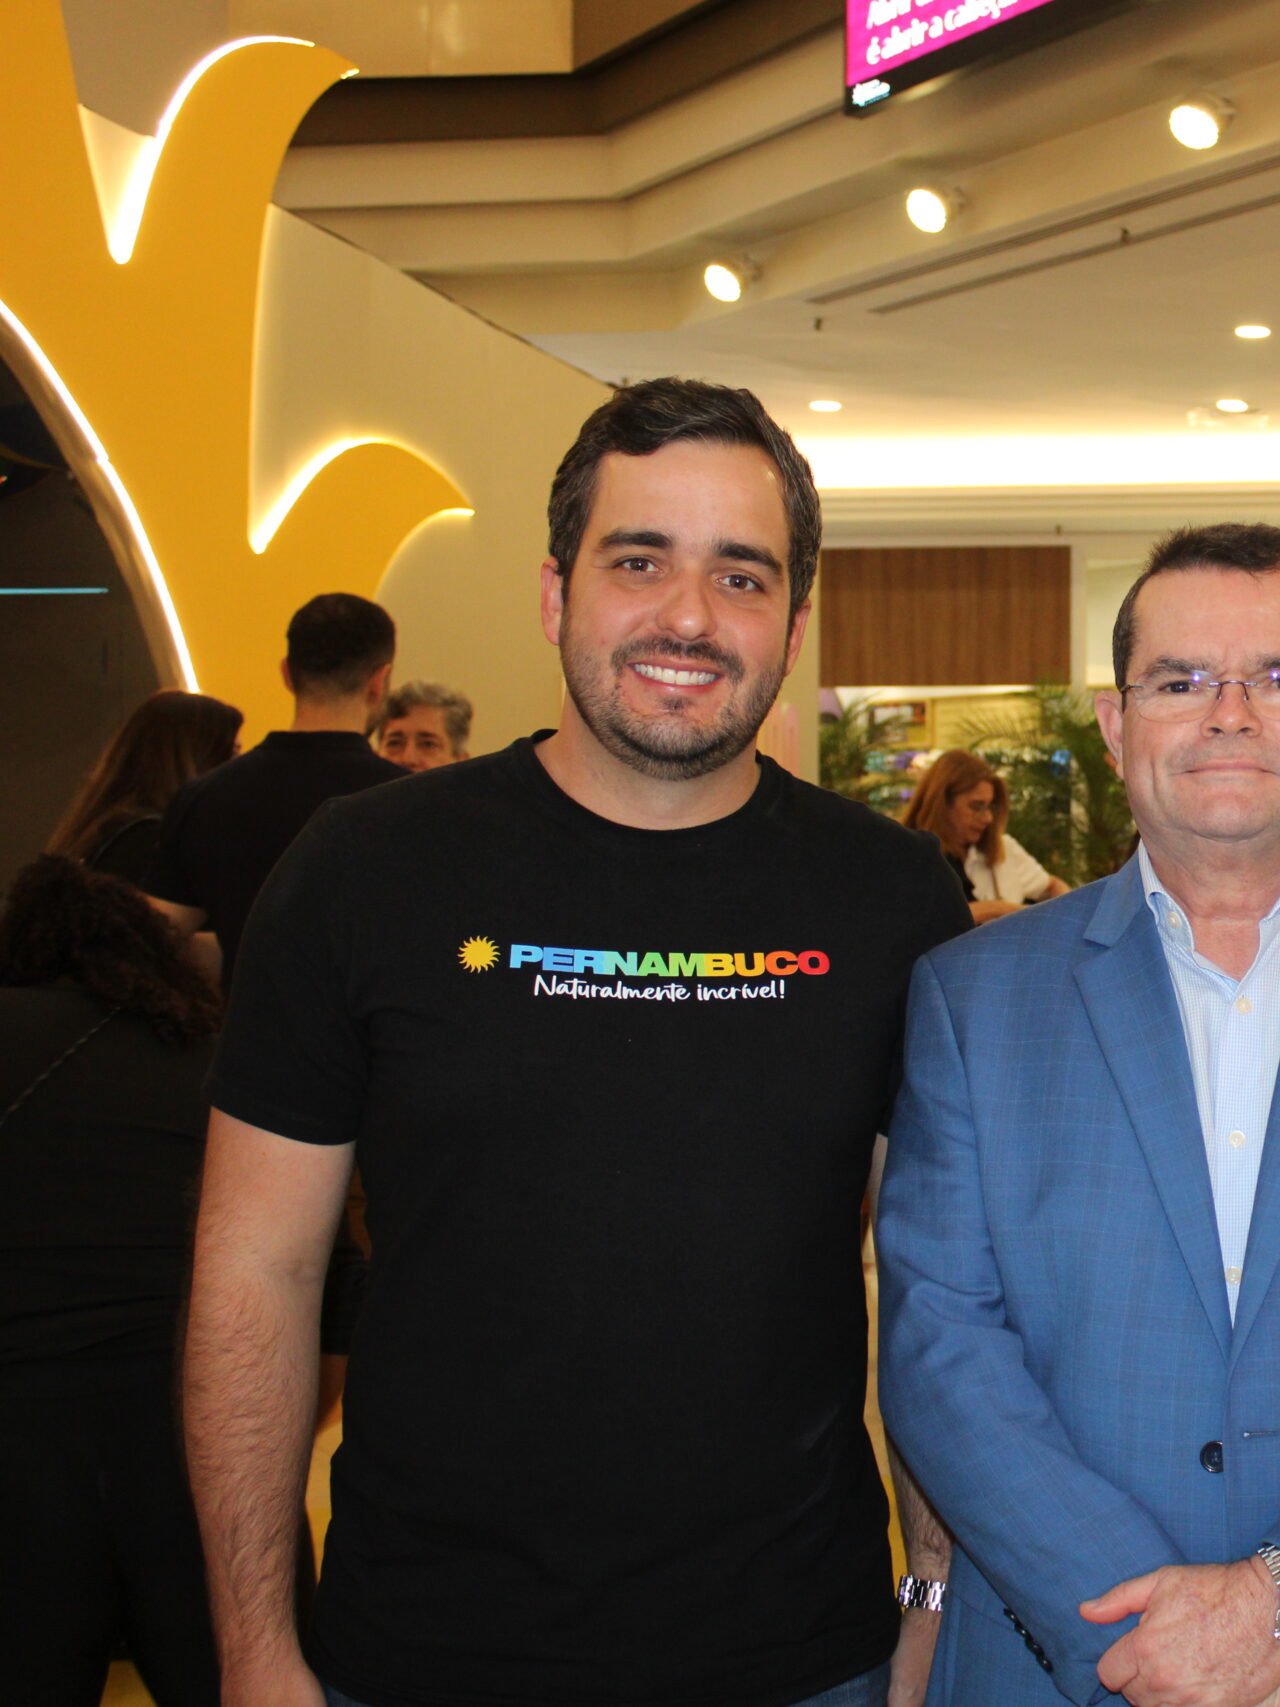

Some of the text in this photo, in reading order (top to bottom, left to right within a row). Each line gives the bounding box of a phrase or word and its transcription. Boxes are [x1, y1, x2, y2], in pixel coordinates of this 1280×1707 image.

[509, 943, 831, 977] PERNAMBUCO
[533, 974, 786, 1002] Naturalmente incrível!
